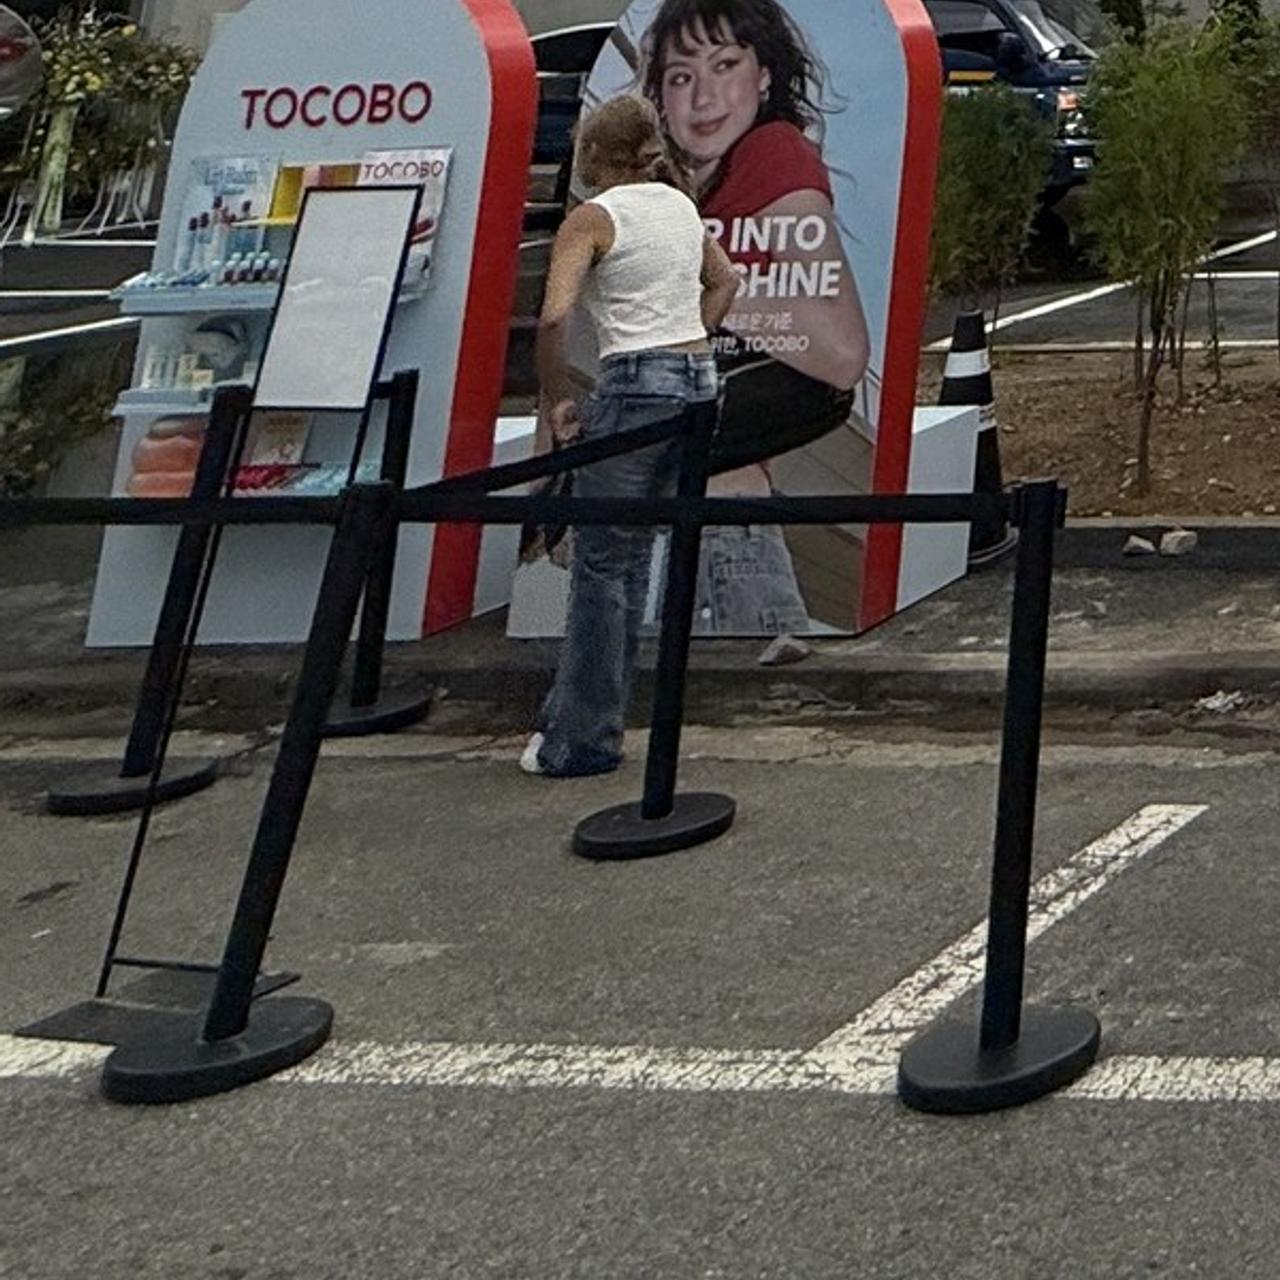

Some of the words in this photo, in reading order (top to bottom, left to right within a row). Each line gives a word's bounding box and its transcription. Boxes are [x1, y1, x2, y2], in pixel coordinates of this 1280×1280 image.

[241, 81, 433, 130] TOCOBO
[364, 159, 445, 180] TOCOBO
[730, 215, 827, 253] INTO
[728, 260, 843, 298] SHINE
[745, 335, 810, 352] TOCOBO
